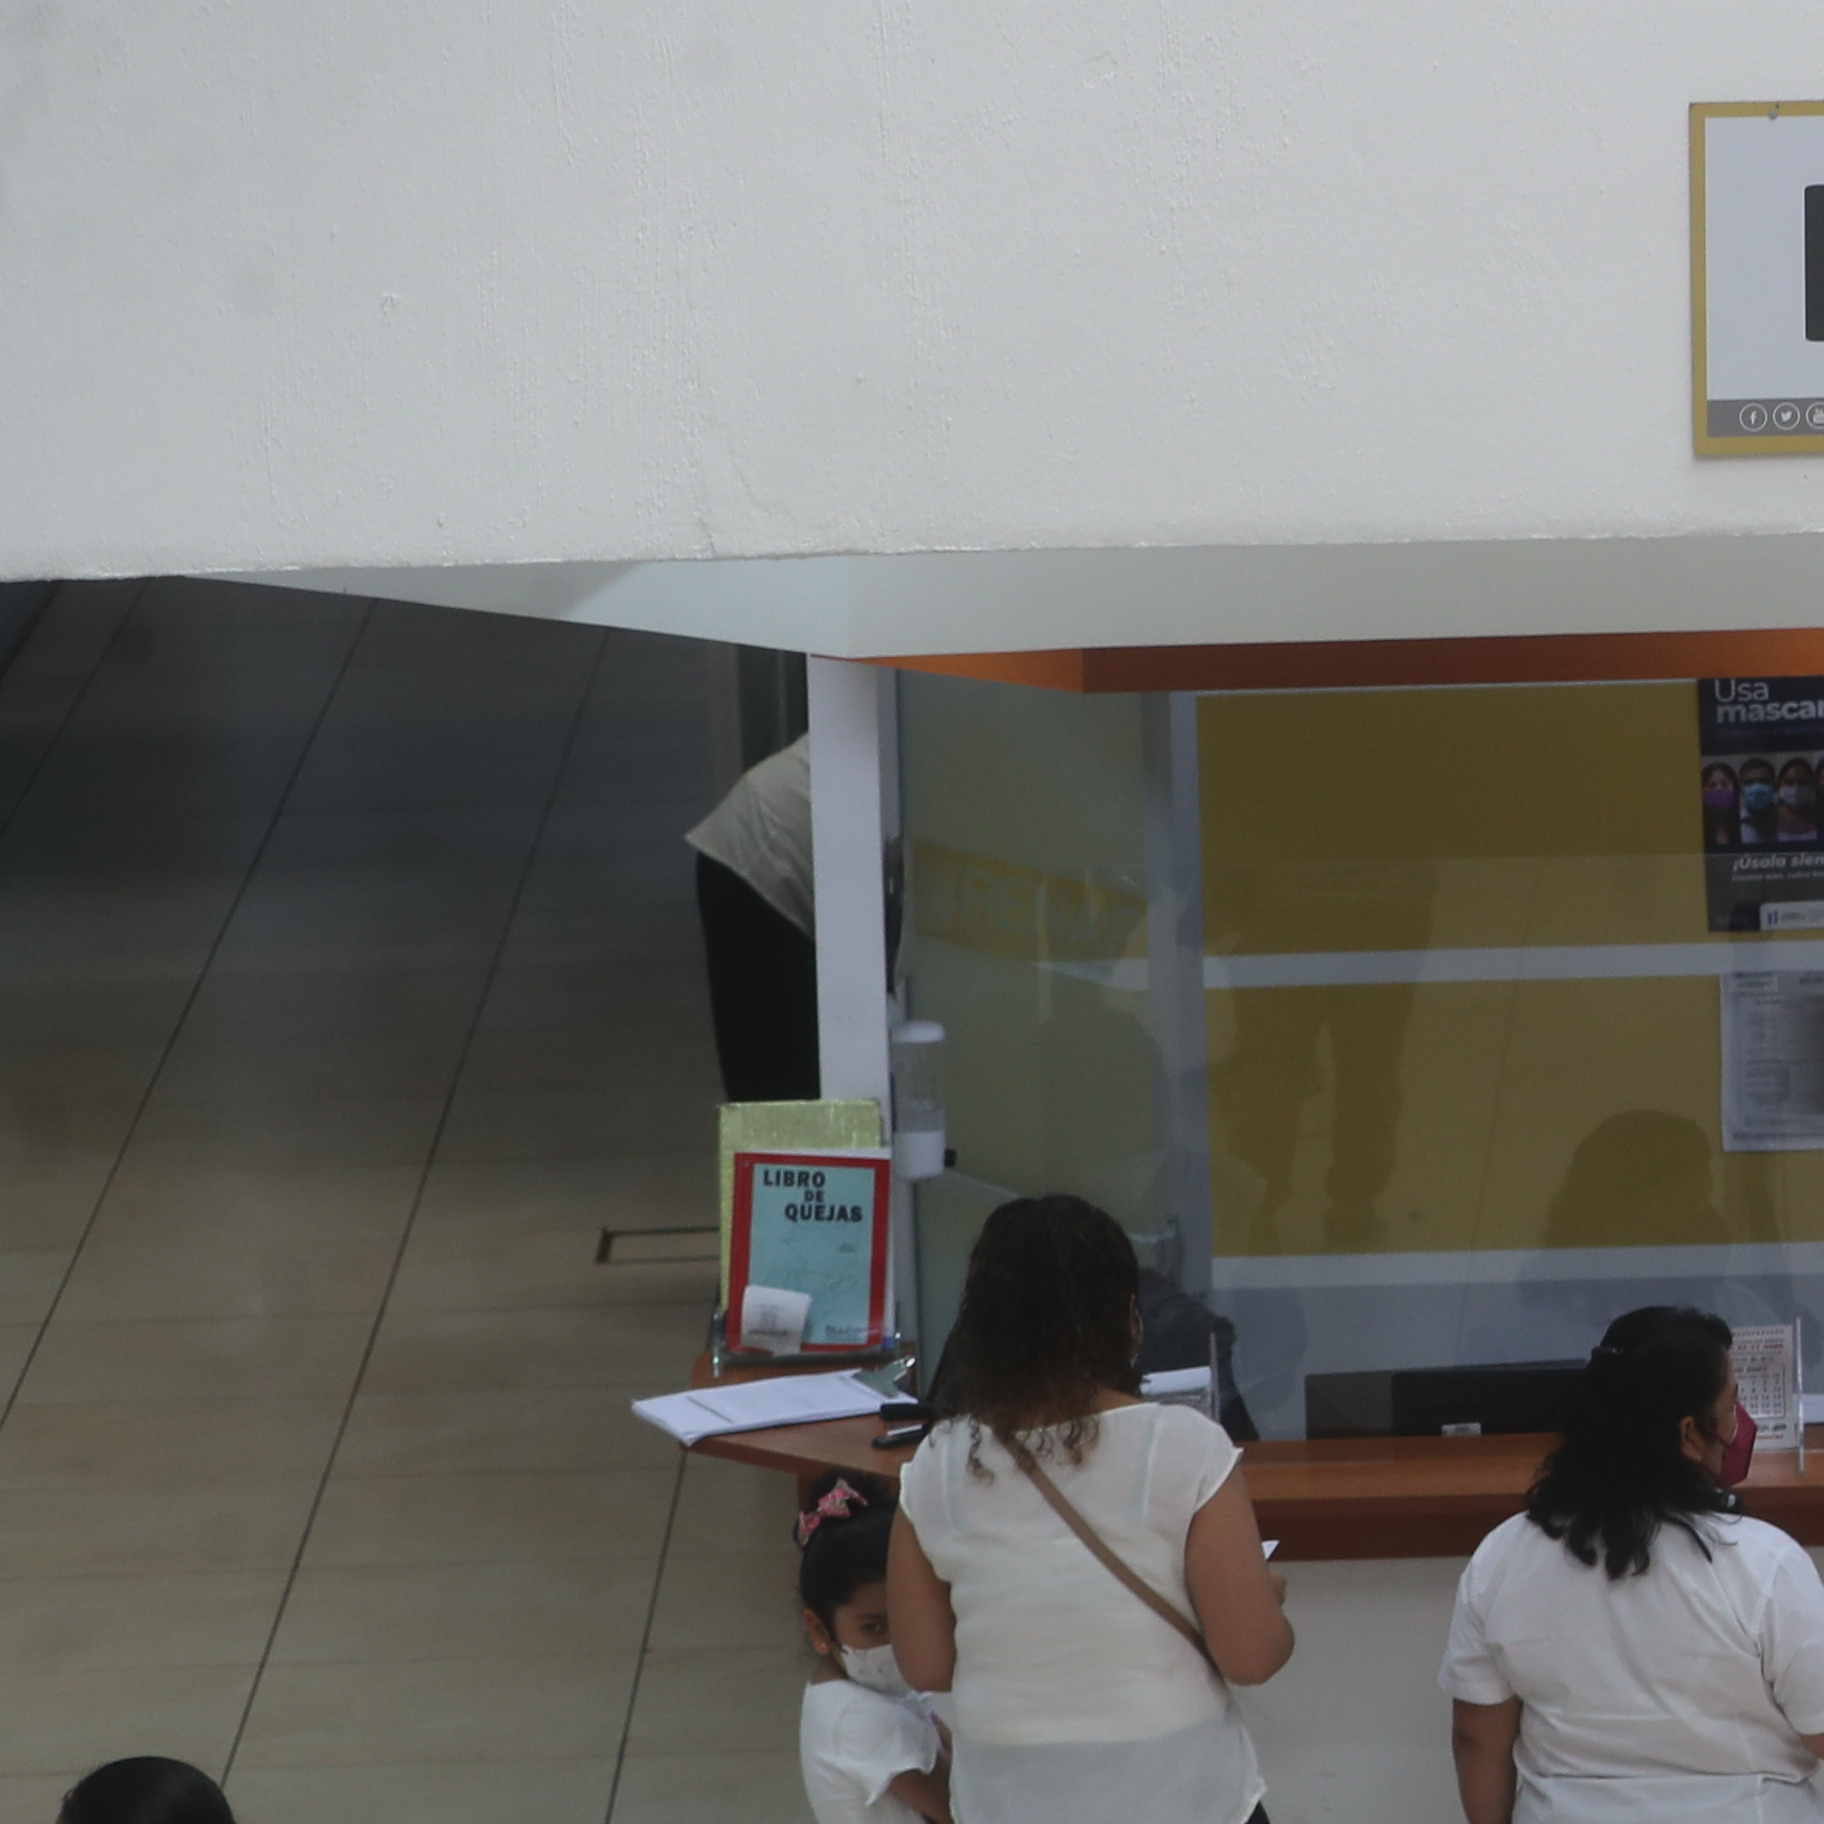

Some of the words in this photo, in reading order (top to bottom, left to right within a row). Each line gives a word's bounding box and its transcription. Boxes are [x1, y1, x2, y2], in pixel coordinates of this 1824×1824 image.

[1713, 677, 1770, 703] Usa
[763, 1168, 826, 1189] LIBRO
[804, 1190, 825, 1203] DE
[784, 1204, 864, 1224] QUEJAS
